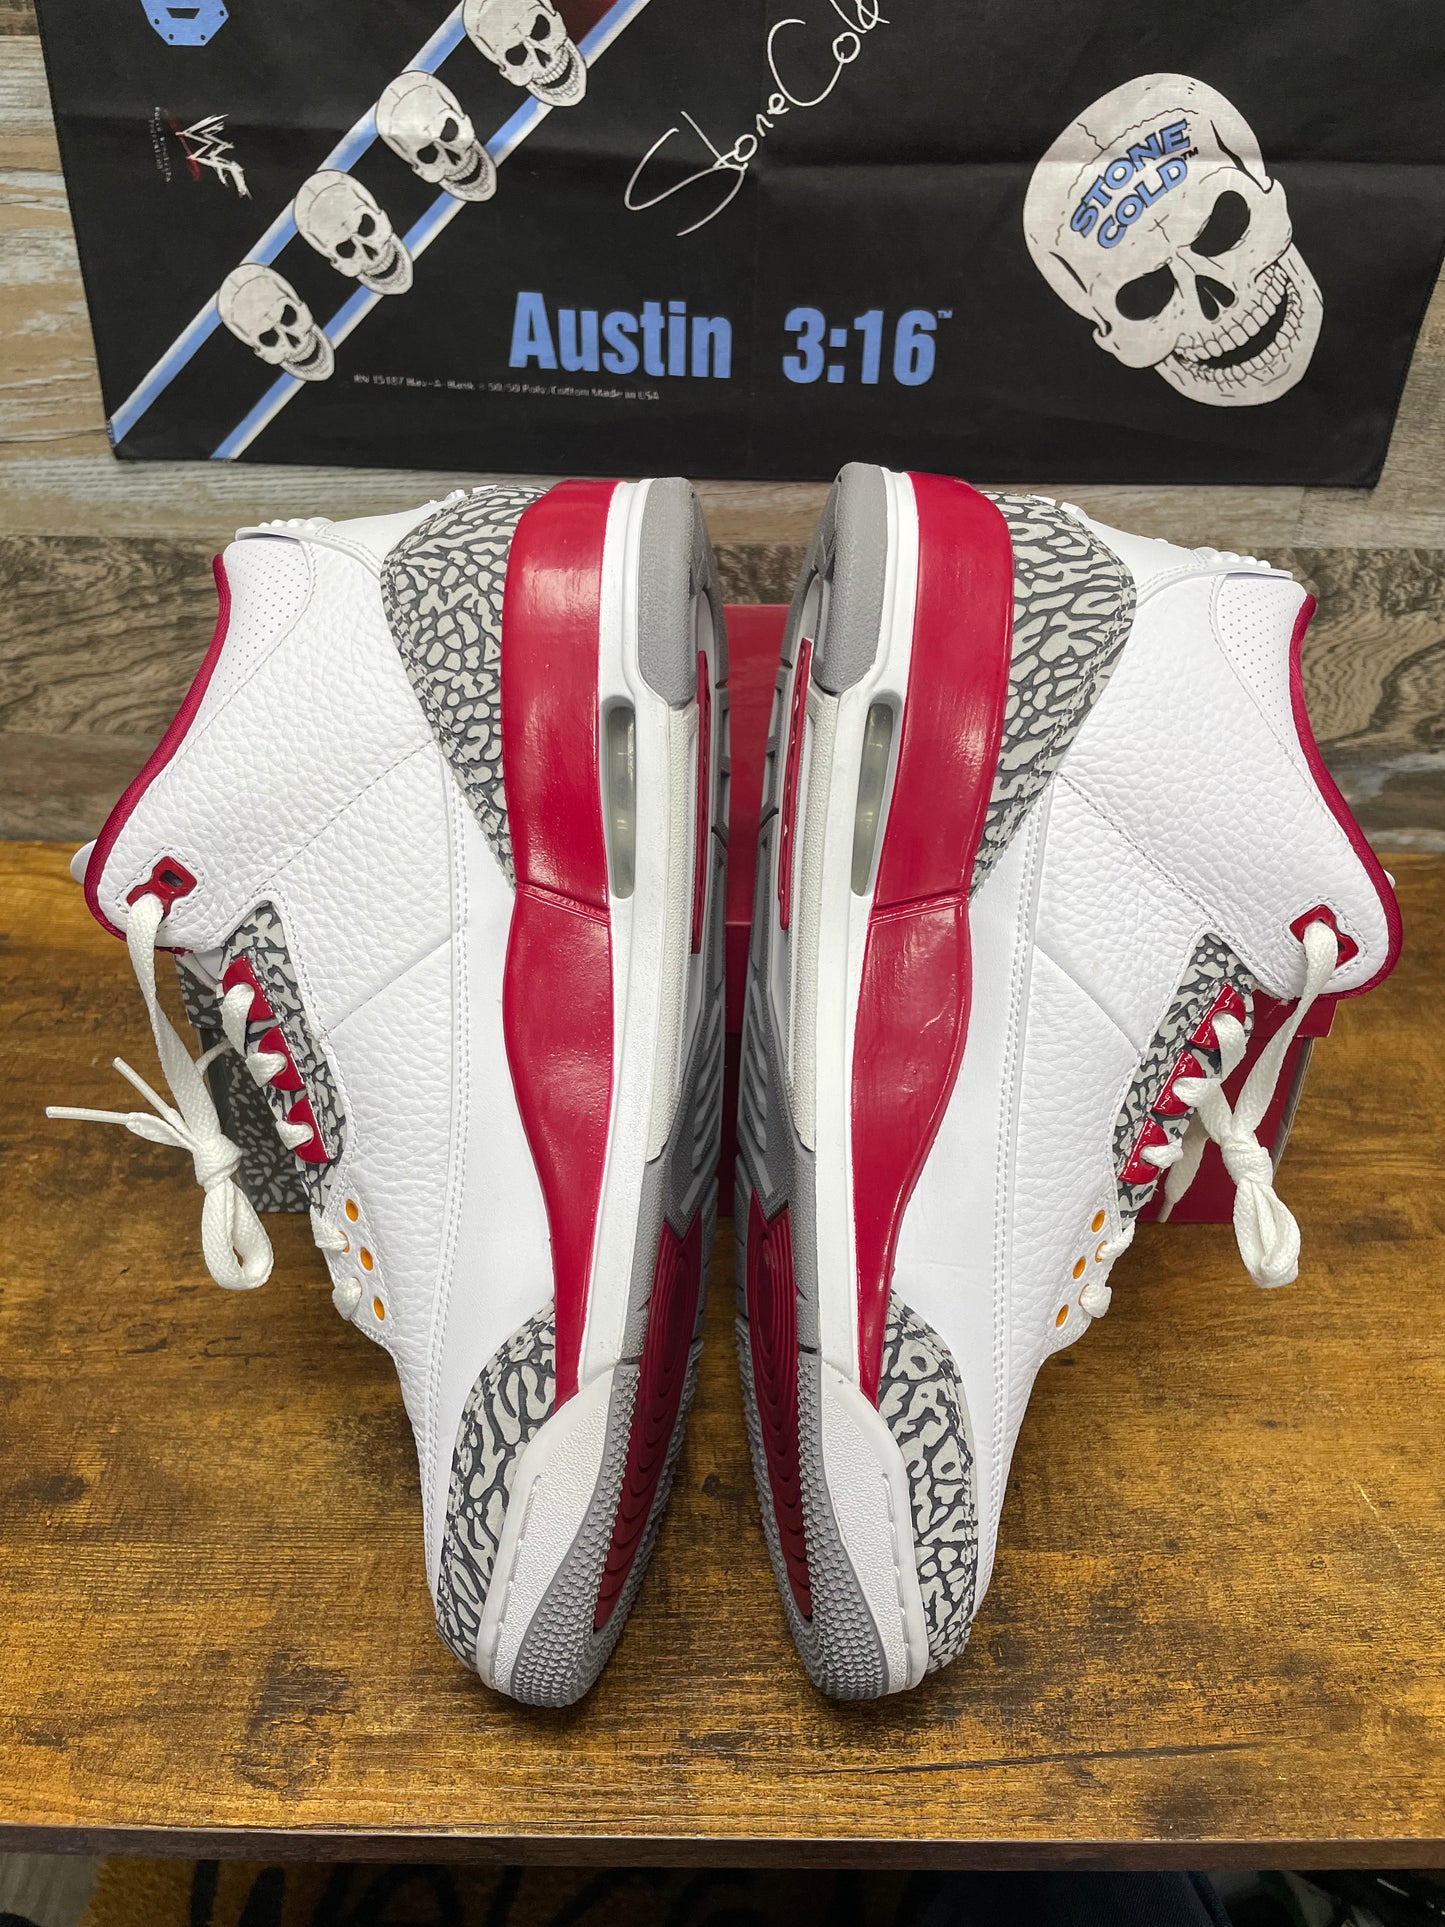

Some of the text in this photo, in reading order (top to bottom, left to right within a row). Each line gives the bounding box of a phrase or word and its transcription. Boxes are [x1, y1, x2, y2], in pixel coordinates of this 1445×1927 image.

[1070, 118, 1191, 239] STONE
[1097, 157, 1188, 249] COLD
[508, 291, 733, 379] Austin
[782, 307, 938, 387] 3:16
[638, 391, 660, 401] USA
